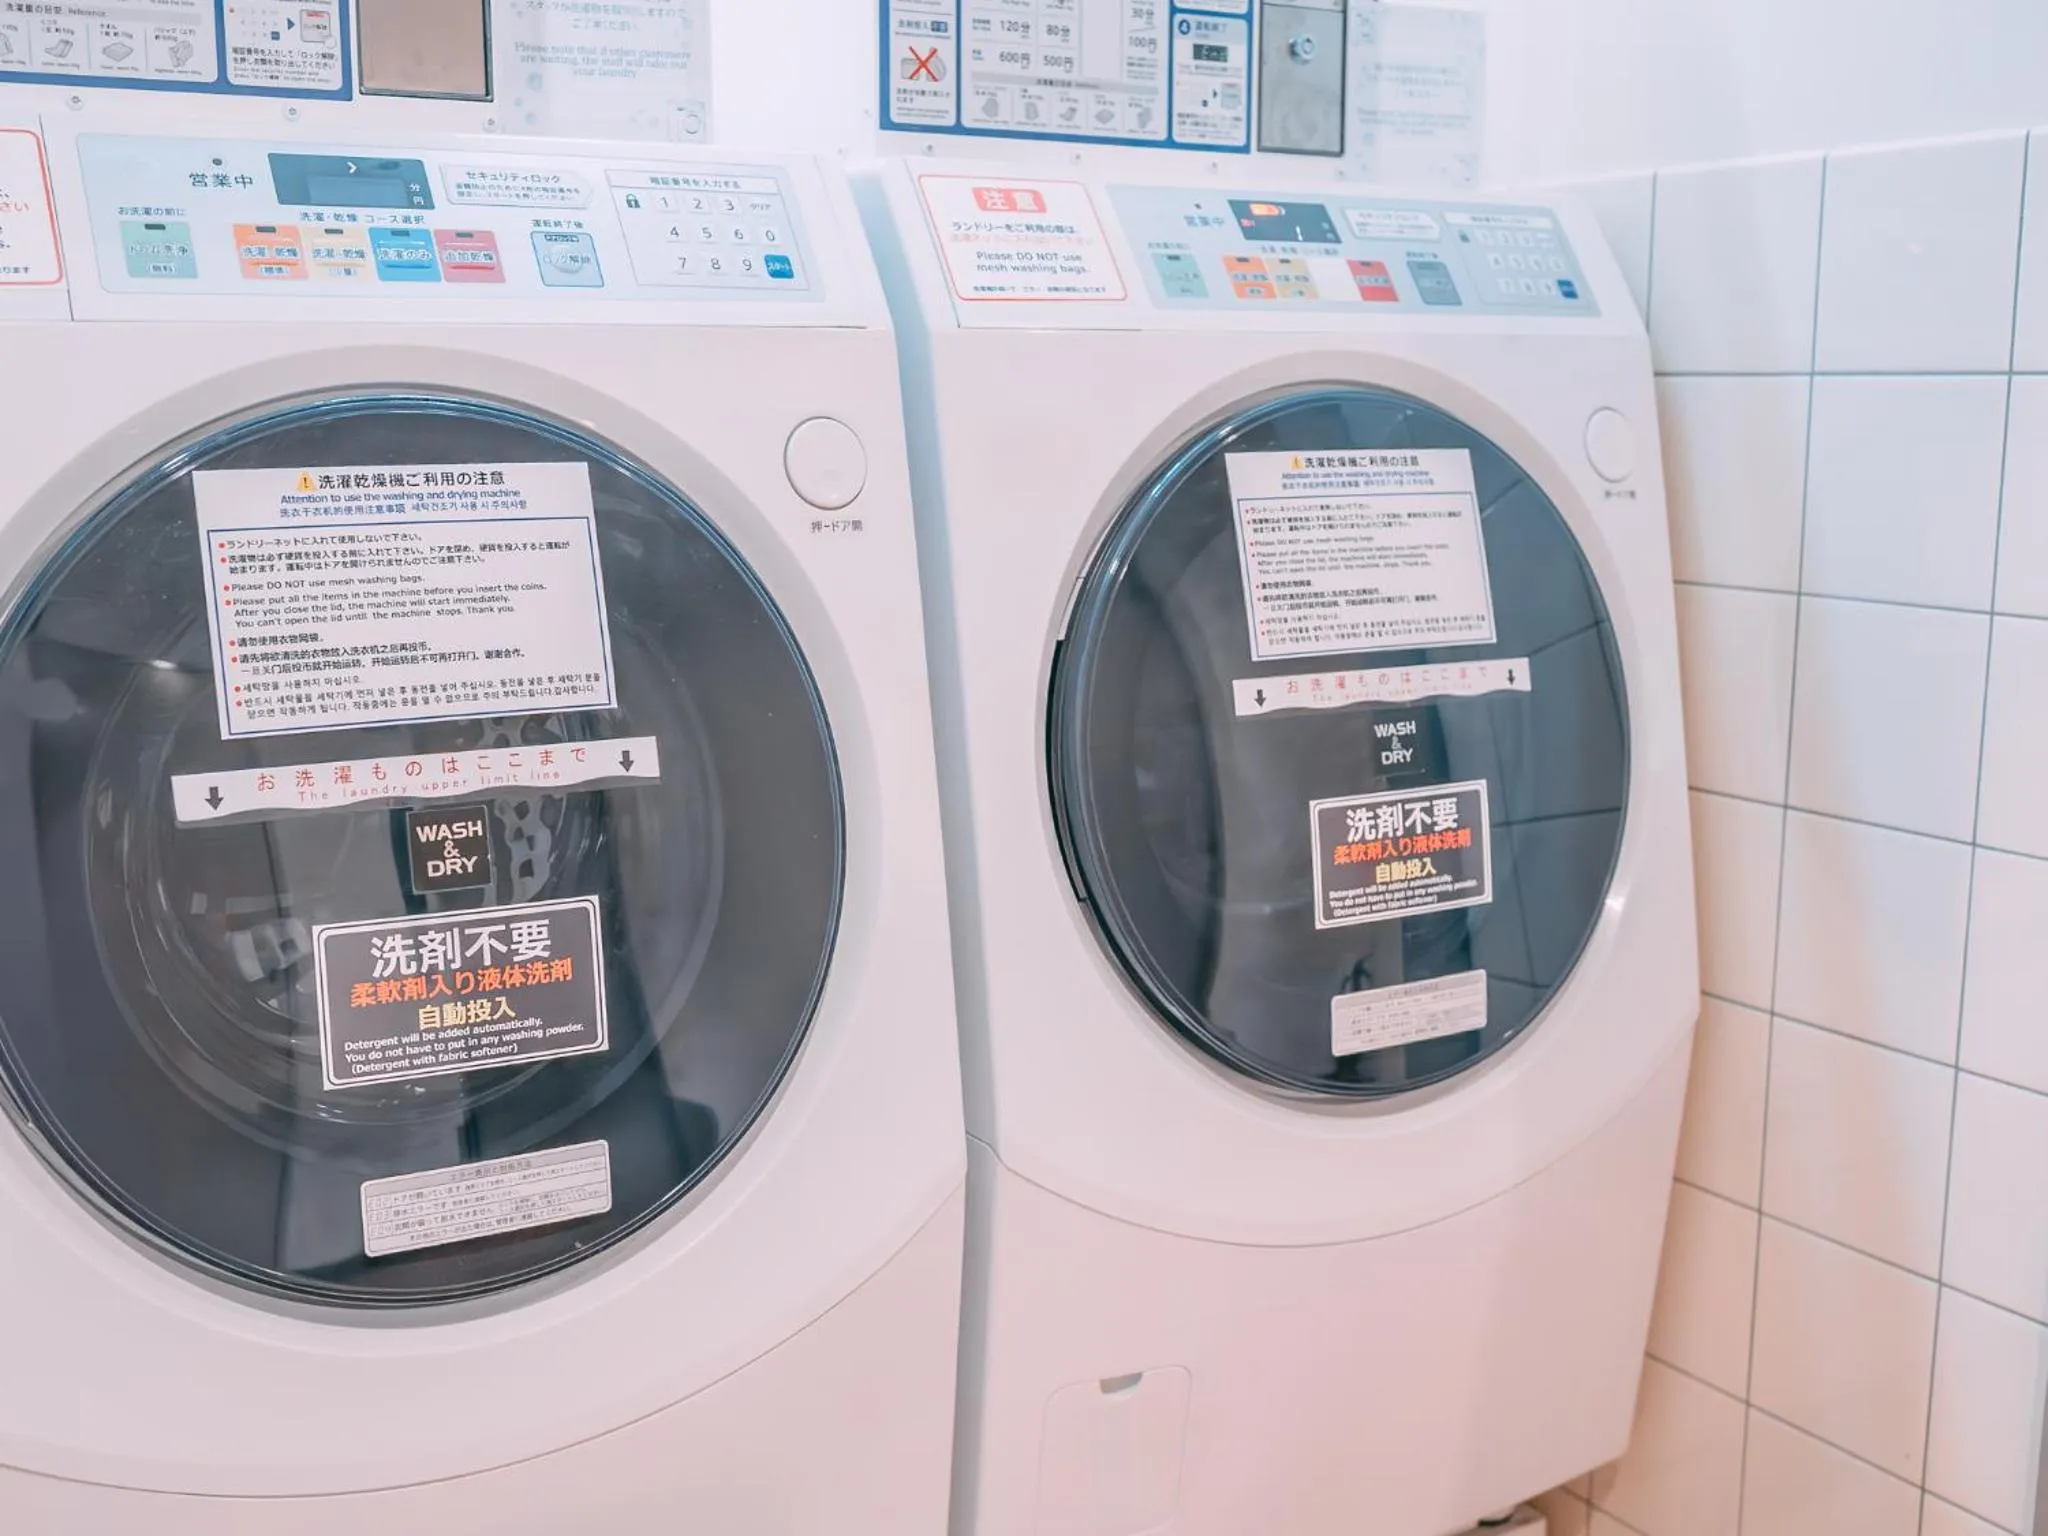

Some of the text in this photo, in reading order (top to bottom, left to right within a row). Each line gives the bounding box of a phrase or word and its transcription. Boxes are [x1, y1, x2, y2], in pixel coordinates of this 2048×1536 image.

[188, 172, 254, 190] 営業中
[465, 171, 561, 184] セキュリティロック
[118, 206, 187, 218] お洗濯の前に
[693, 199, 702, 210] 2
[726, 200, 735, 211] 3
[670, 226, 680, 238] 4
[702, 227, 712, 239] 5
[734, 229, 744, 241] 6
[678, 257, 752, 271] 7 8 9
[976, 251, 1082, 263] Please DO NOT use
[976, 263, 1008, 273] mesh
[1012, 264, 1057, 275] washing
[318, 470, 505, 489] 洗濯乾燥機ご利用の注意
[281, 489, 521, 504] Attention to use the washing and drying machine
[231, 574, 426, 592] Please DO NOT use mesh washing bags.
[233, 597, 265, 606] Please
[268, 595, 285, 606] put
[288, 594, 300, 603] all
[302, 593, 319, 602] the
[351, 591, 361, 600] in
[362, 590, 379, 599] the
[381, 589, 421, 598] machine
[424, 587, 454, 596] before
[457, 587, 474, 596] you
[476, 584, 502, 593] insert
[504, 583, 519, 592] the
[521, 582, 548, 591] coins.
[234, 594, 511, 618] After you close the lid, the machine will start immediately.
[235, 619, 255, 628] You
[257, 617, 282, 627] can't
[284, 617, 310, 627] open
[312, 614, 328, 624] the
[331, 613, 343, 623] lid
[345, 612, 368, 622] until
[372, 611, 388, 620] the
[391, 609, 431, 619] machine
[466, 605, 495, 615] Thank
[1373, 720, 1417, 738] WASH
[1390, 736, 1402, 750] &
[1381, 748, 1414, 766] DRY
[257, 747, 586, 792] お洗濯ものはここまで
[299, 770, 561, 802] The laundry upper limit line
[1346, 797, 1459, 842] 洗剤不要
[415, 820, 483, 843] WASH
[443, 839, 460, 858] &
[1333, 827, 1472, 866] 柔軟剤入り液体洗剤
[427, 855, 477, 878] DRY
[1375, 857, 1437, 884] 自動投入
[370, 918, 551, 979] 洗剤不要
[350, 957, 573, 1008] 柔軟剤入り液体洗剤
[418, 996, 517, 1030] 自動投入
[344, 1017, 543, 1052] Detergent will be added automatically.
[345, 1022, 585, 1063] You do not have to put in any washing powder.
[351, 1042, 518, 1075] (Detergent with fabric softener)
